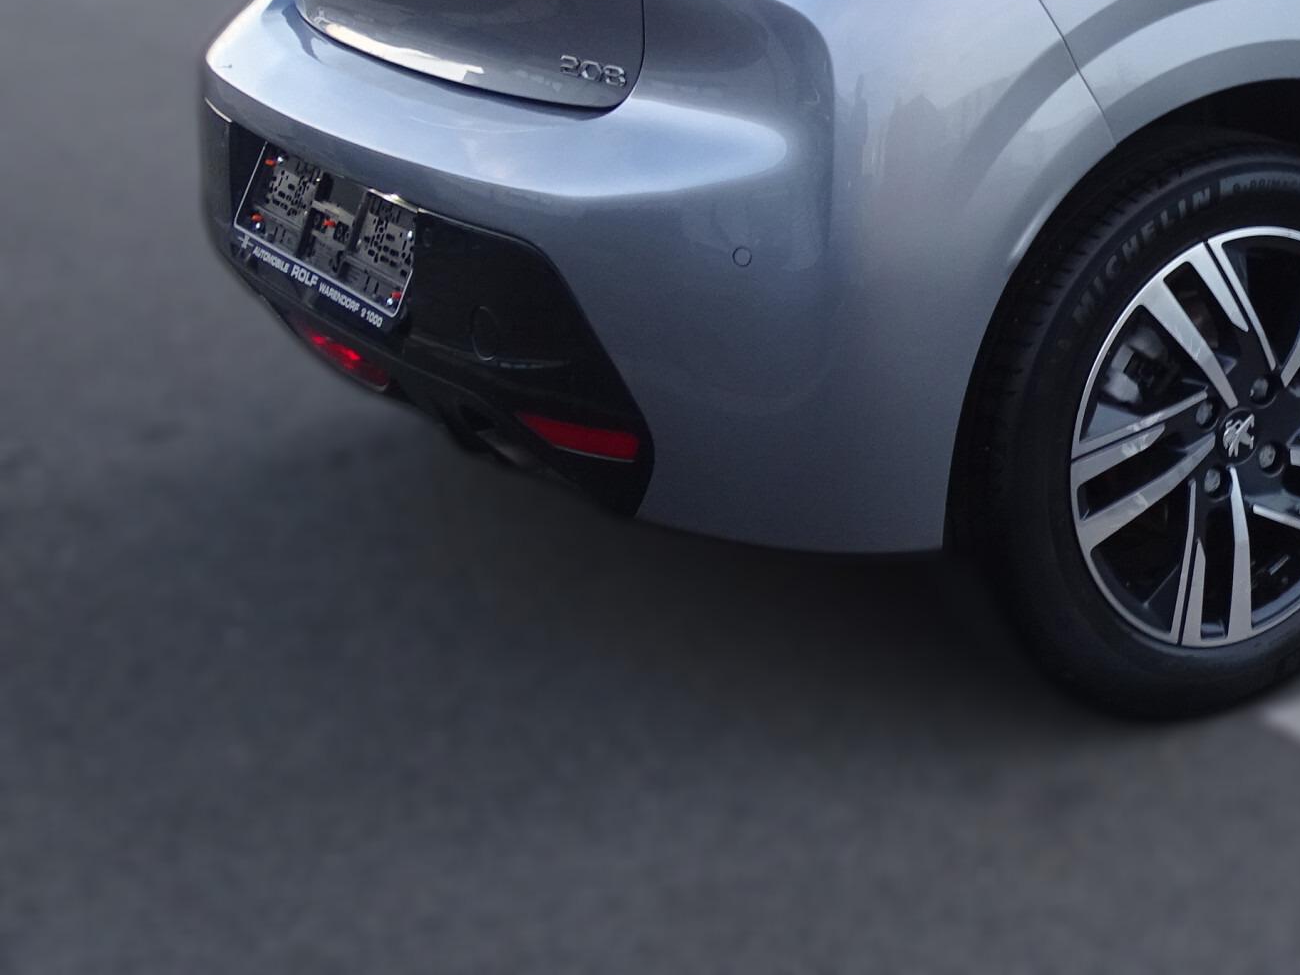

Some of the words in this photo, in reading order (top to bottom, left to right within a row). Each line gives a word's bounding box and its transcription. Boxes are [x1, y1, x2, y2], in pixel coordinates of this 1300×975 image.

[559, 54, 627, 87] 208
[1072, 185, 1211, 324] MICHELIN
[290, 264, 319, 287] ROLF
